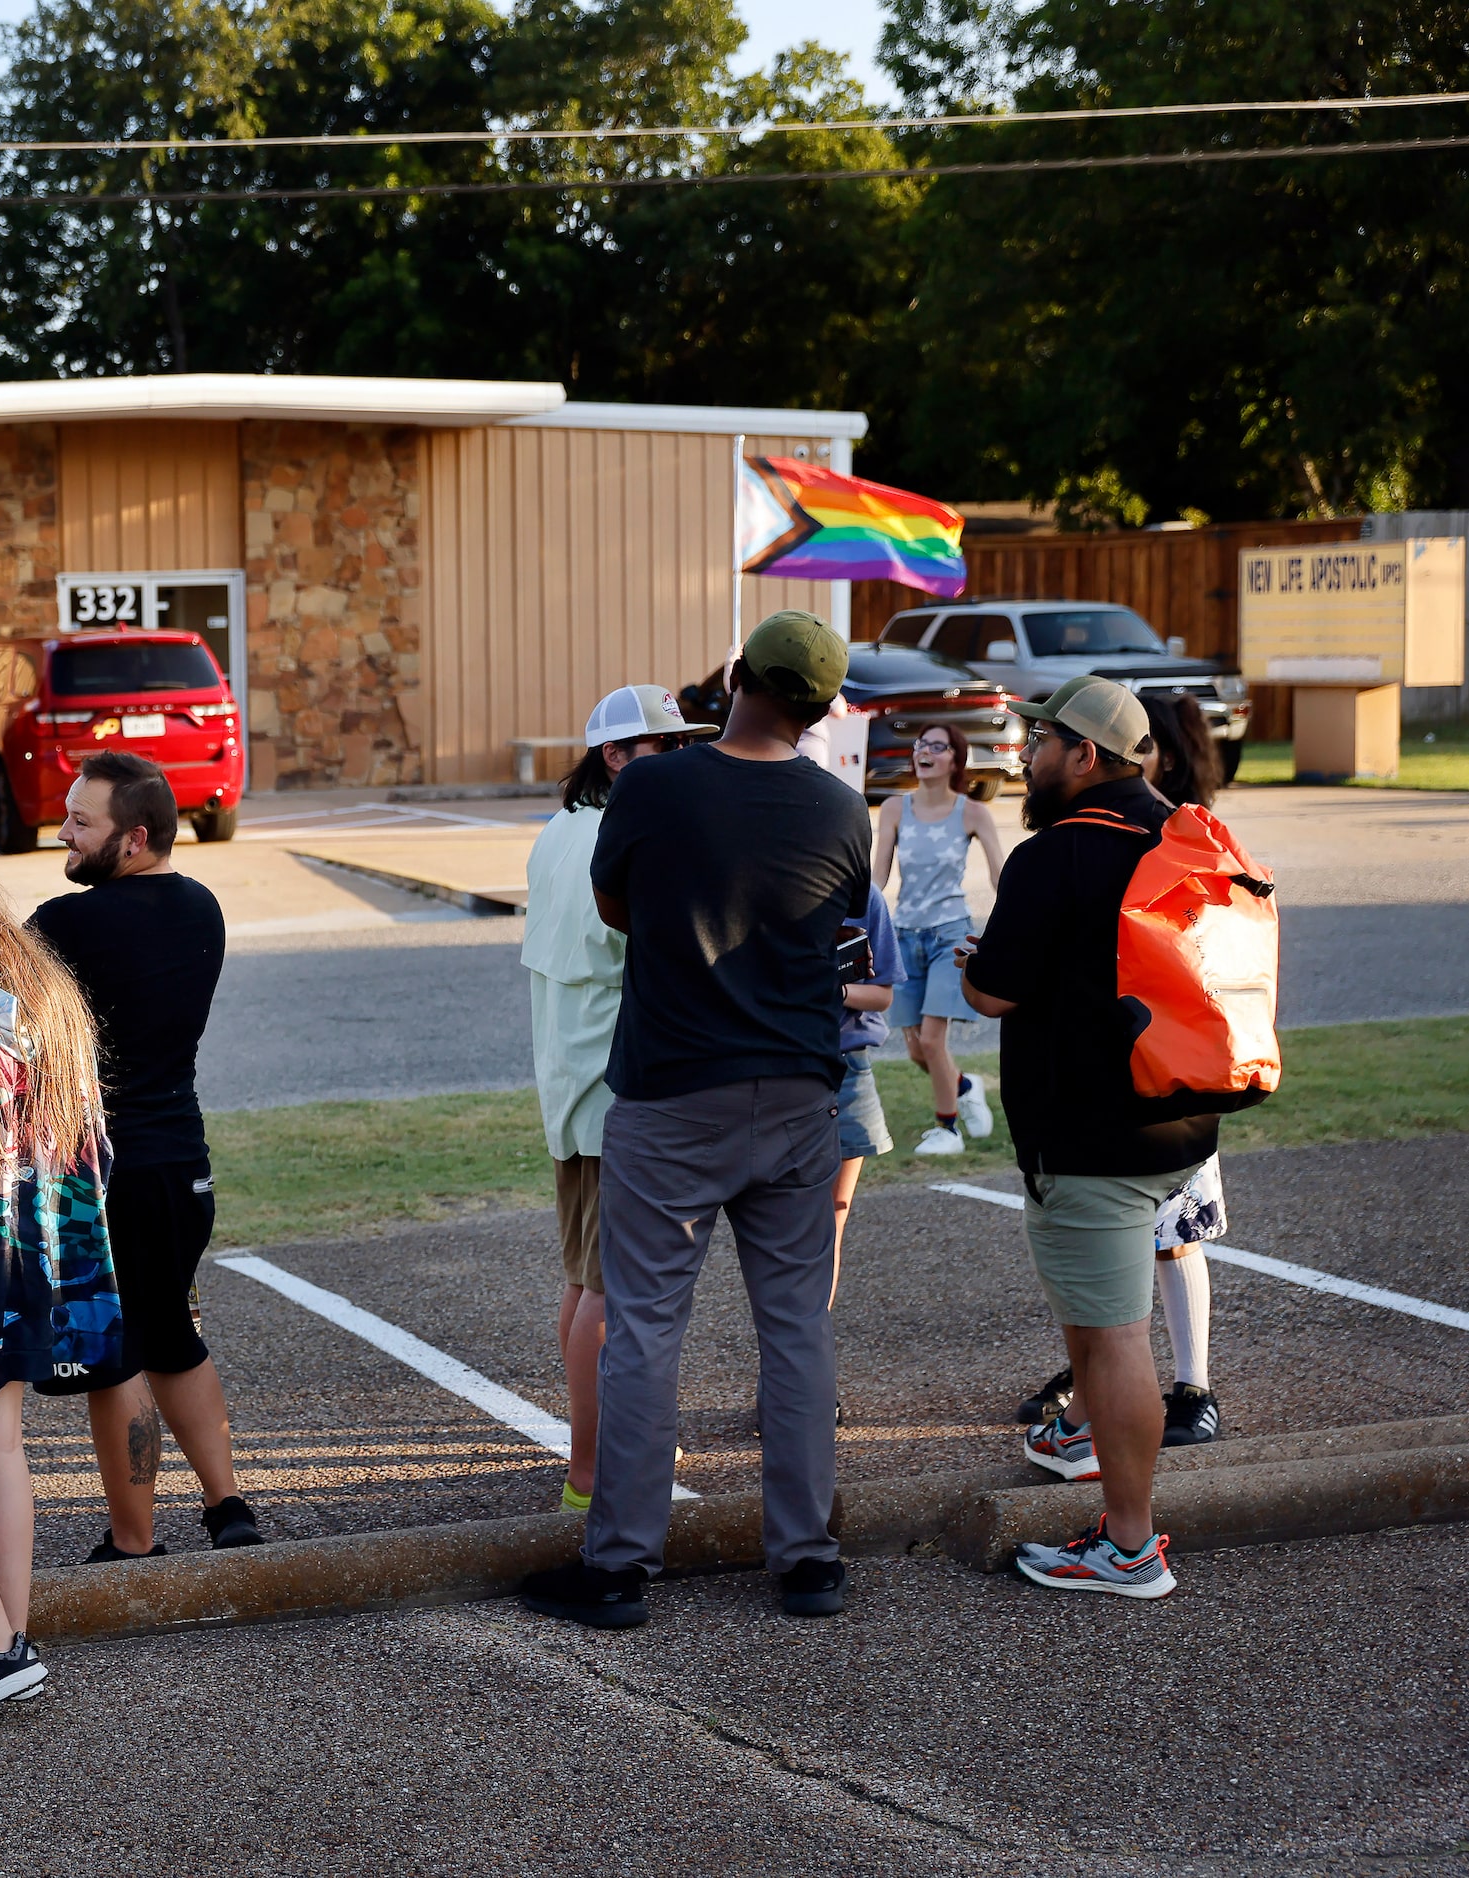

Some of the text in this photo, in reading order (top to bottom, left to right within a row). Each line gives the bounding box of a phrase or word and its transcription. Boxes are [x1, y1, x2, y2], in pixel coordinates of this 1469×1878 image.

[1246, 559, 1272, 594] NEW
[1278, 557, 1303, 594] LIFE
[1309, 553, 1378, 592] APOSTOLIC
[76, 587, 137, 622] 332
